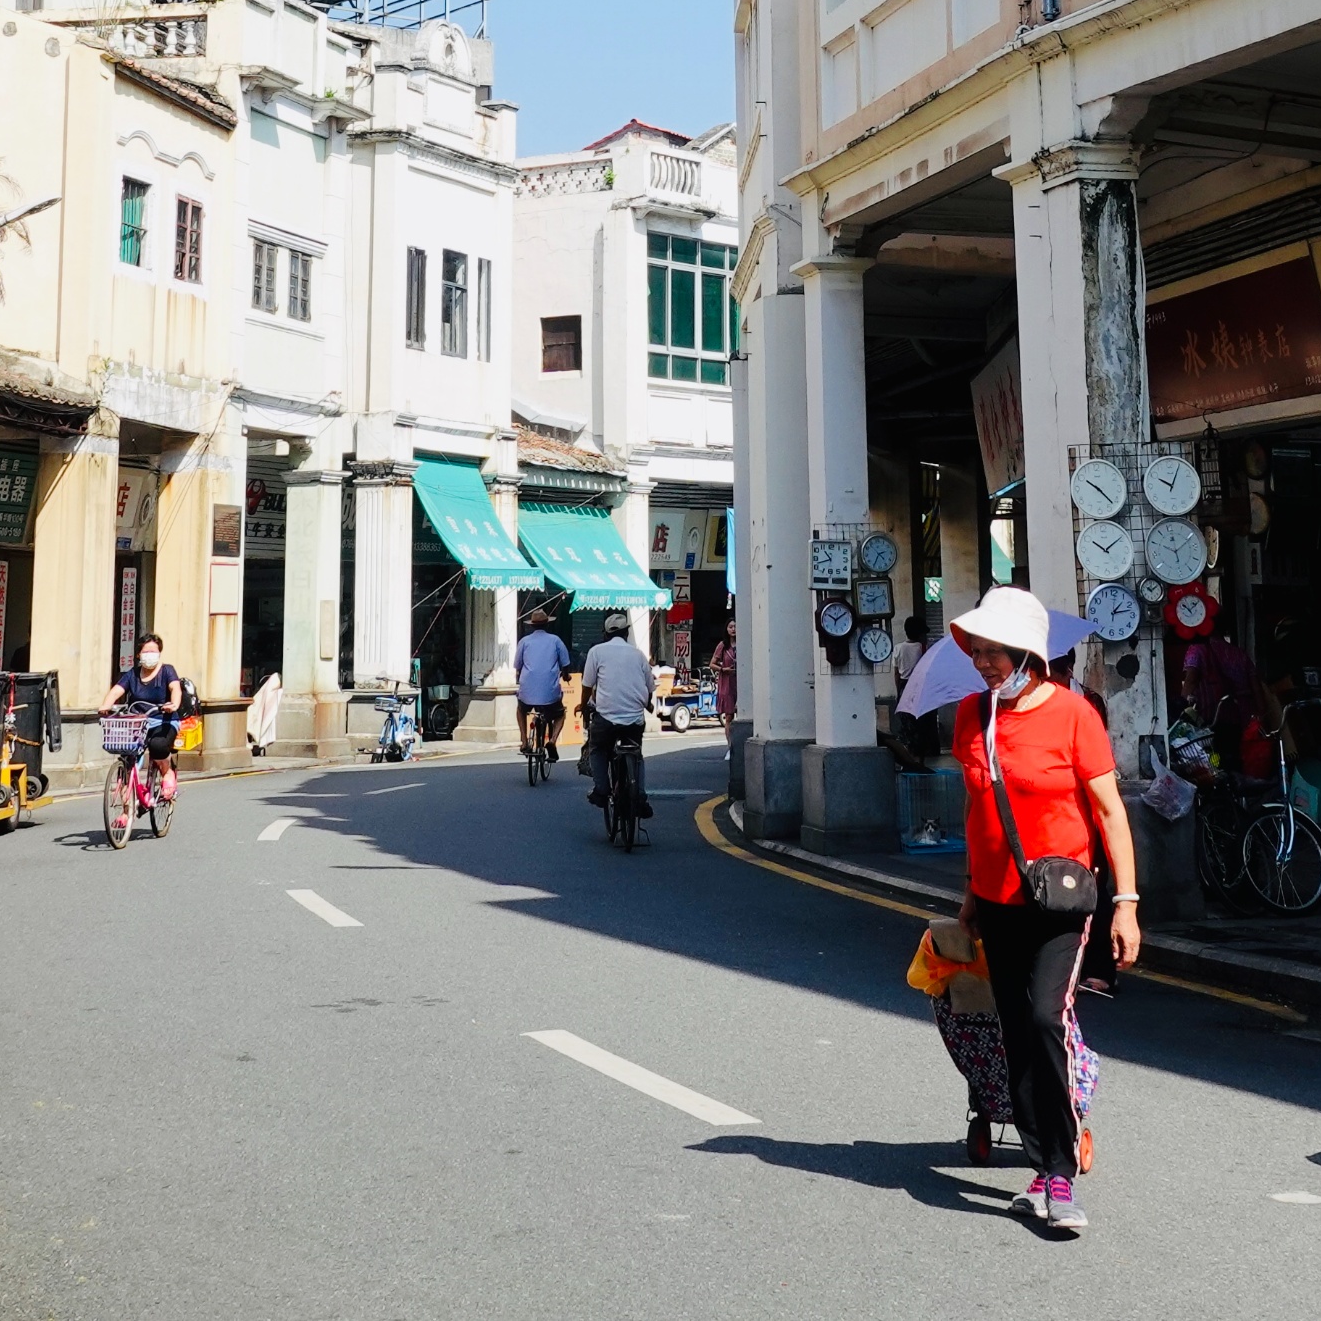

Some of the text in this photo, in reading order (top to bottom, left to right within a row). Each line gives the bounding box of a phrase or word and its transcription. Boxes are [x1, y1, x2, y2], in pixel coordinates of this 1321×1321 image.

[652, 523, 670, 554] 店
[1110, 589, 1118, 597] 12
[1089, 607, 1096, 615] 9
